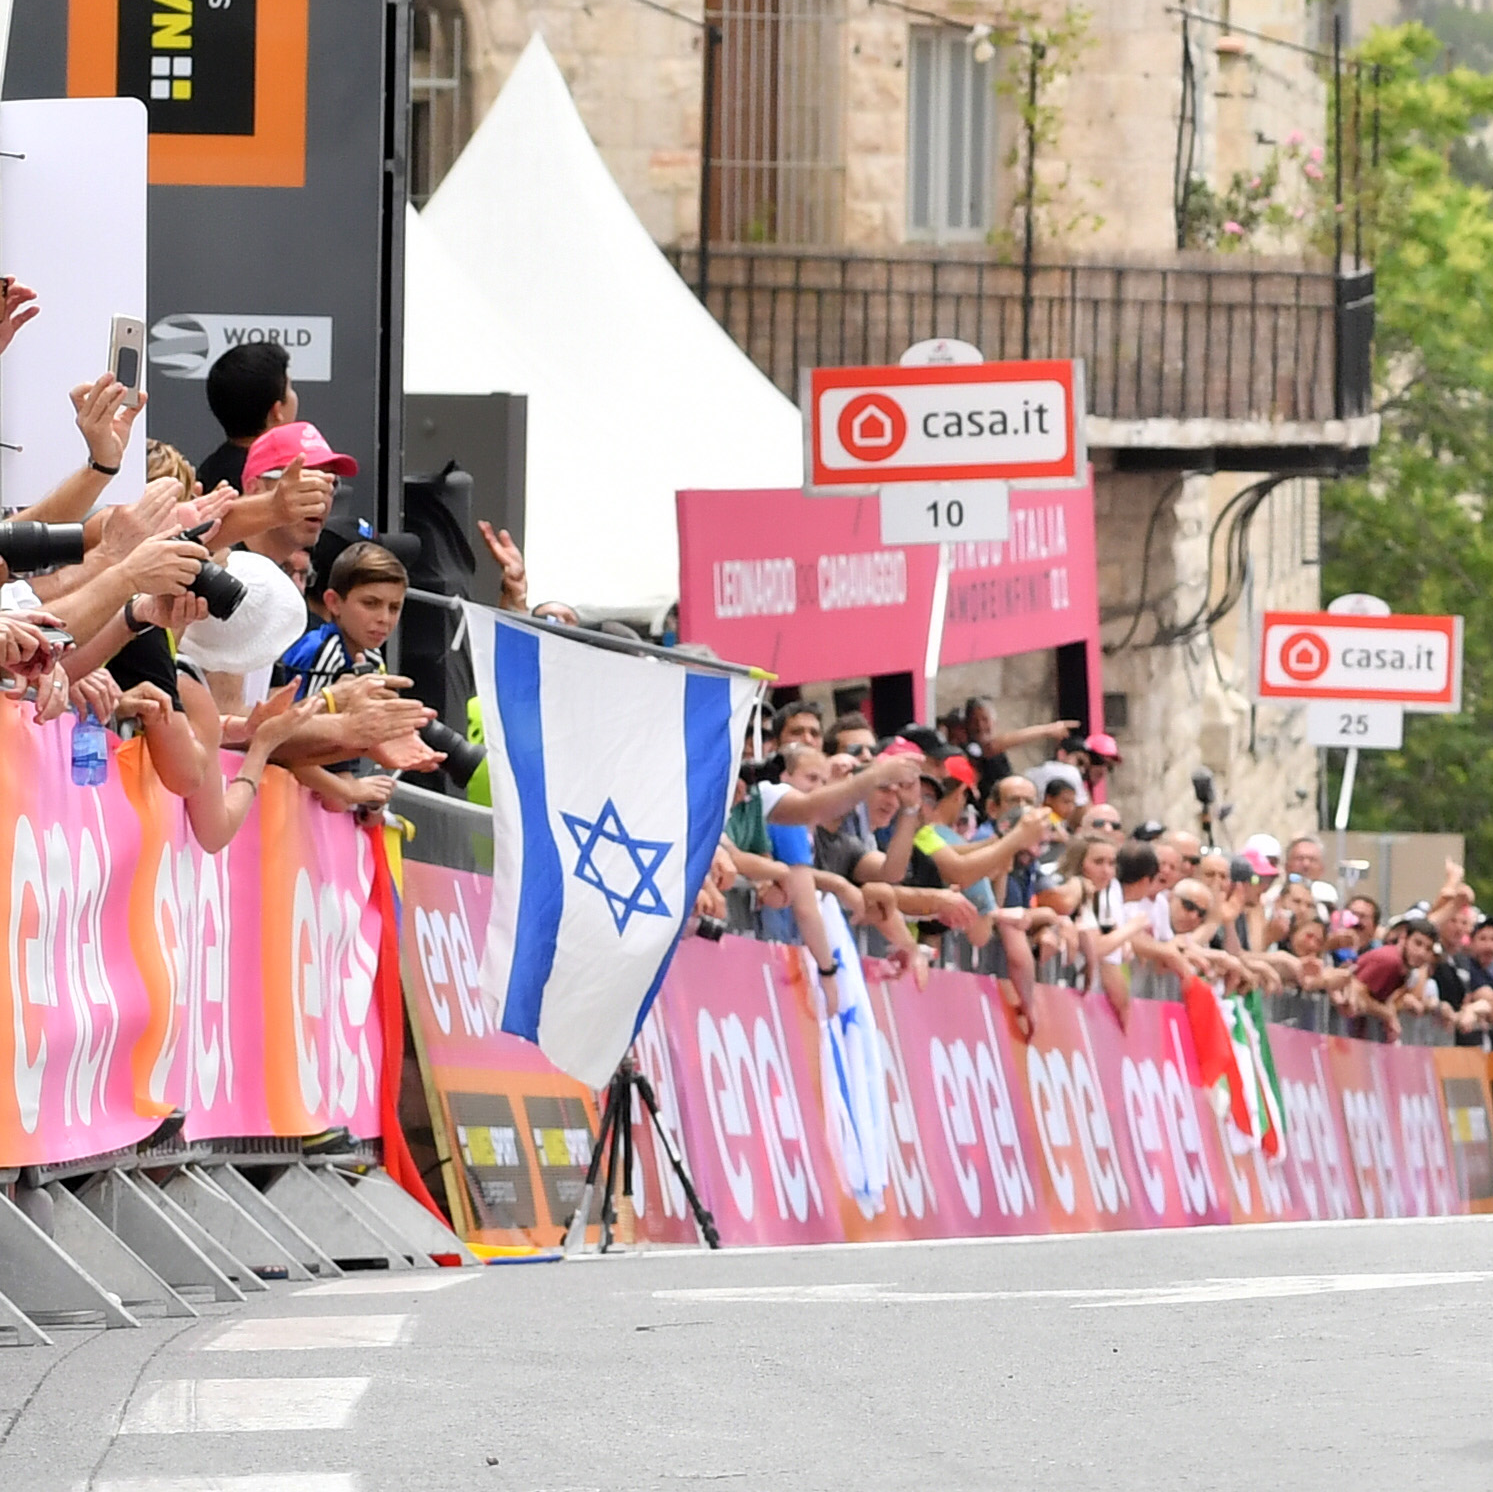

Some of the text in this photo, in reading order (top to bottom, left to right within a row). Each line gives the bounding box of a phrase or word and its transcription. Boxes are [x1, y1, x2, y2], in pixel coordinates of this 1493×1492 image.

[224, 327, 312, 347] WORLD
[922, 399, 1050, 439] casa.it
[926, 500, 964, 528] 10
[1338, 714, 1369, 736] 25
[1340, 645, 1436, 673] casa.it
[11, 785, 119, 1135] enel
[148, 838, 235, 1111] enel
[696, 963, 825, 1224] enel
[929, 994, 1037, 1220] enel
[1025, 1006, 1132, 1215] enel
[1121, 1016, 1220, 1217] enel
